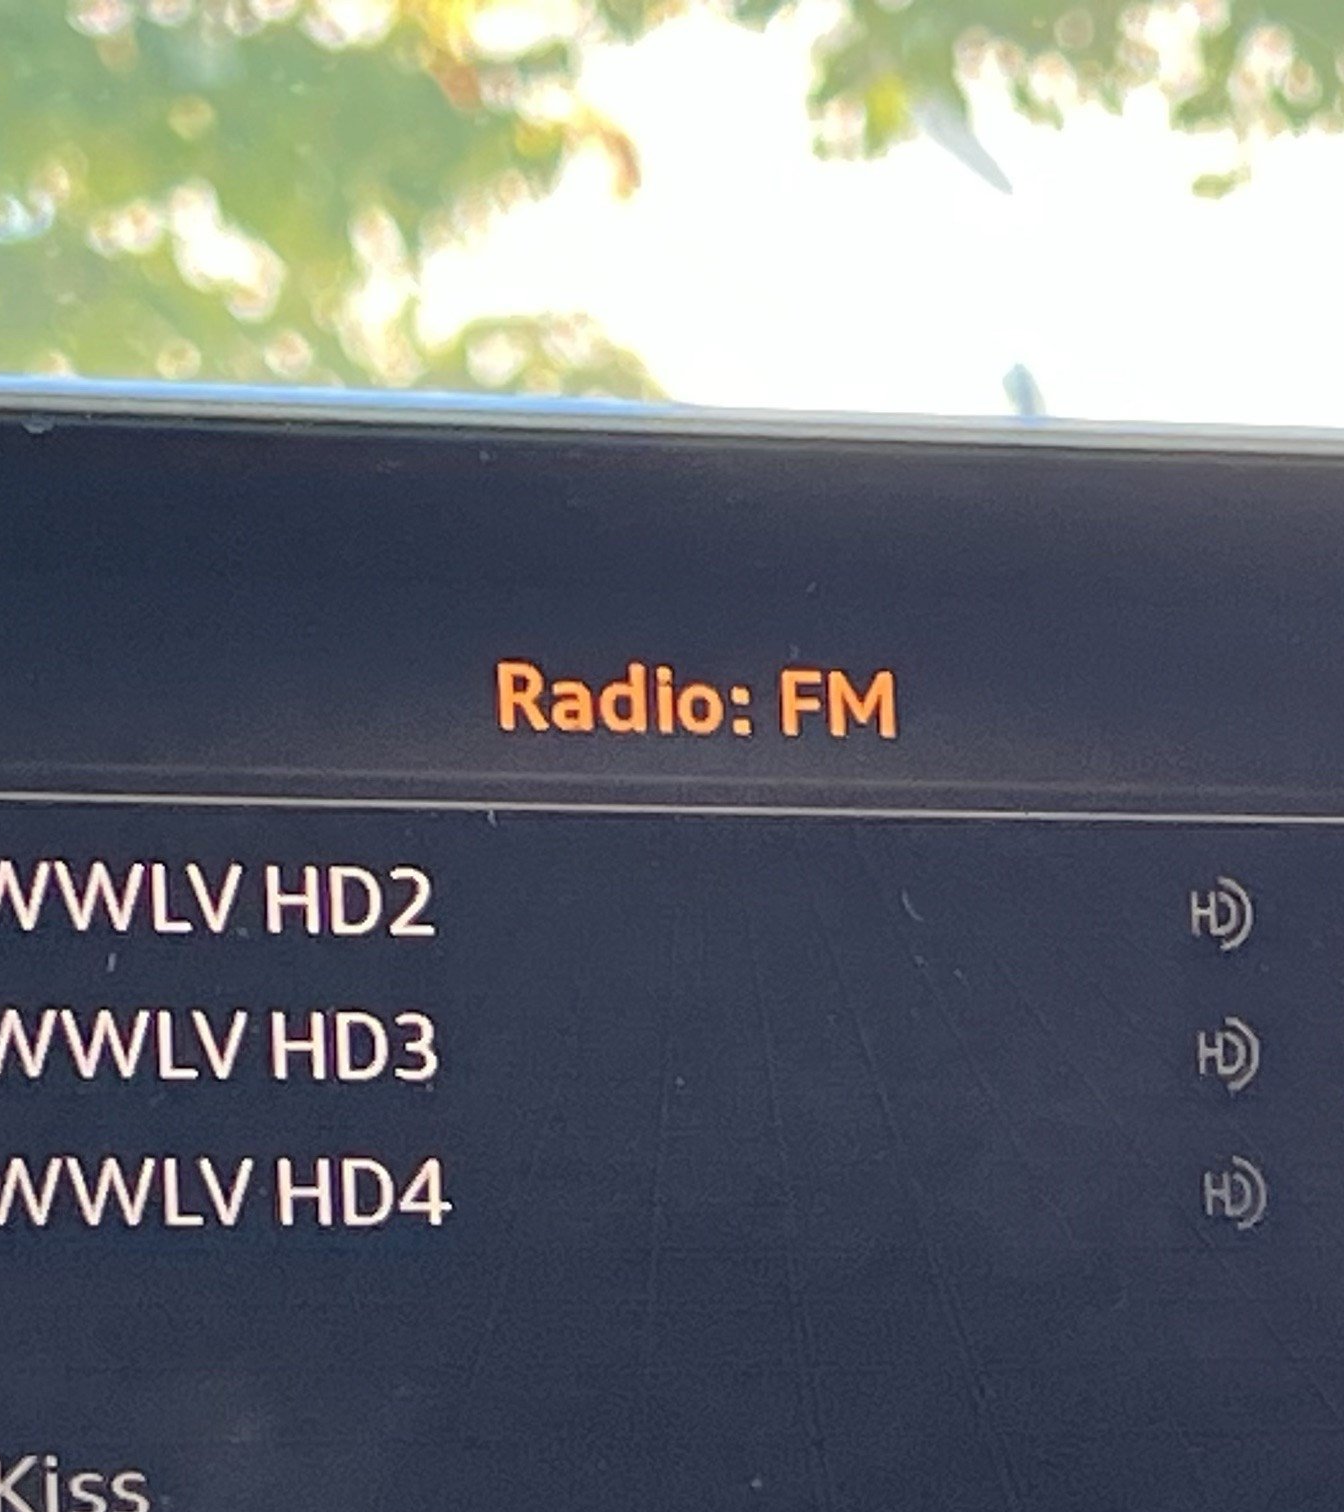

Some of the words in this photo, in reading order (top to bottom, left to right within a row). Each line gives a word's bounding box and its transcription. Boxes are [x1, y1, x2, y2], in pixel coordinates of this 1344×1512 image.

[496, 660, 752, 736] Radio:
[779, 669, 897, 739] FM
[266, 867, 436, 937] HD2
[273, 1012, 439, 1082] HD3
[278, 1157, 453, 1228] HD4
